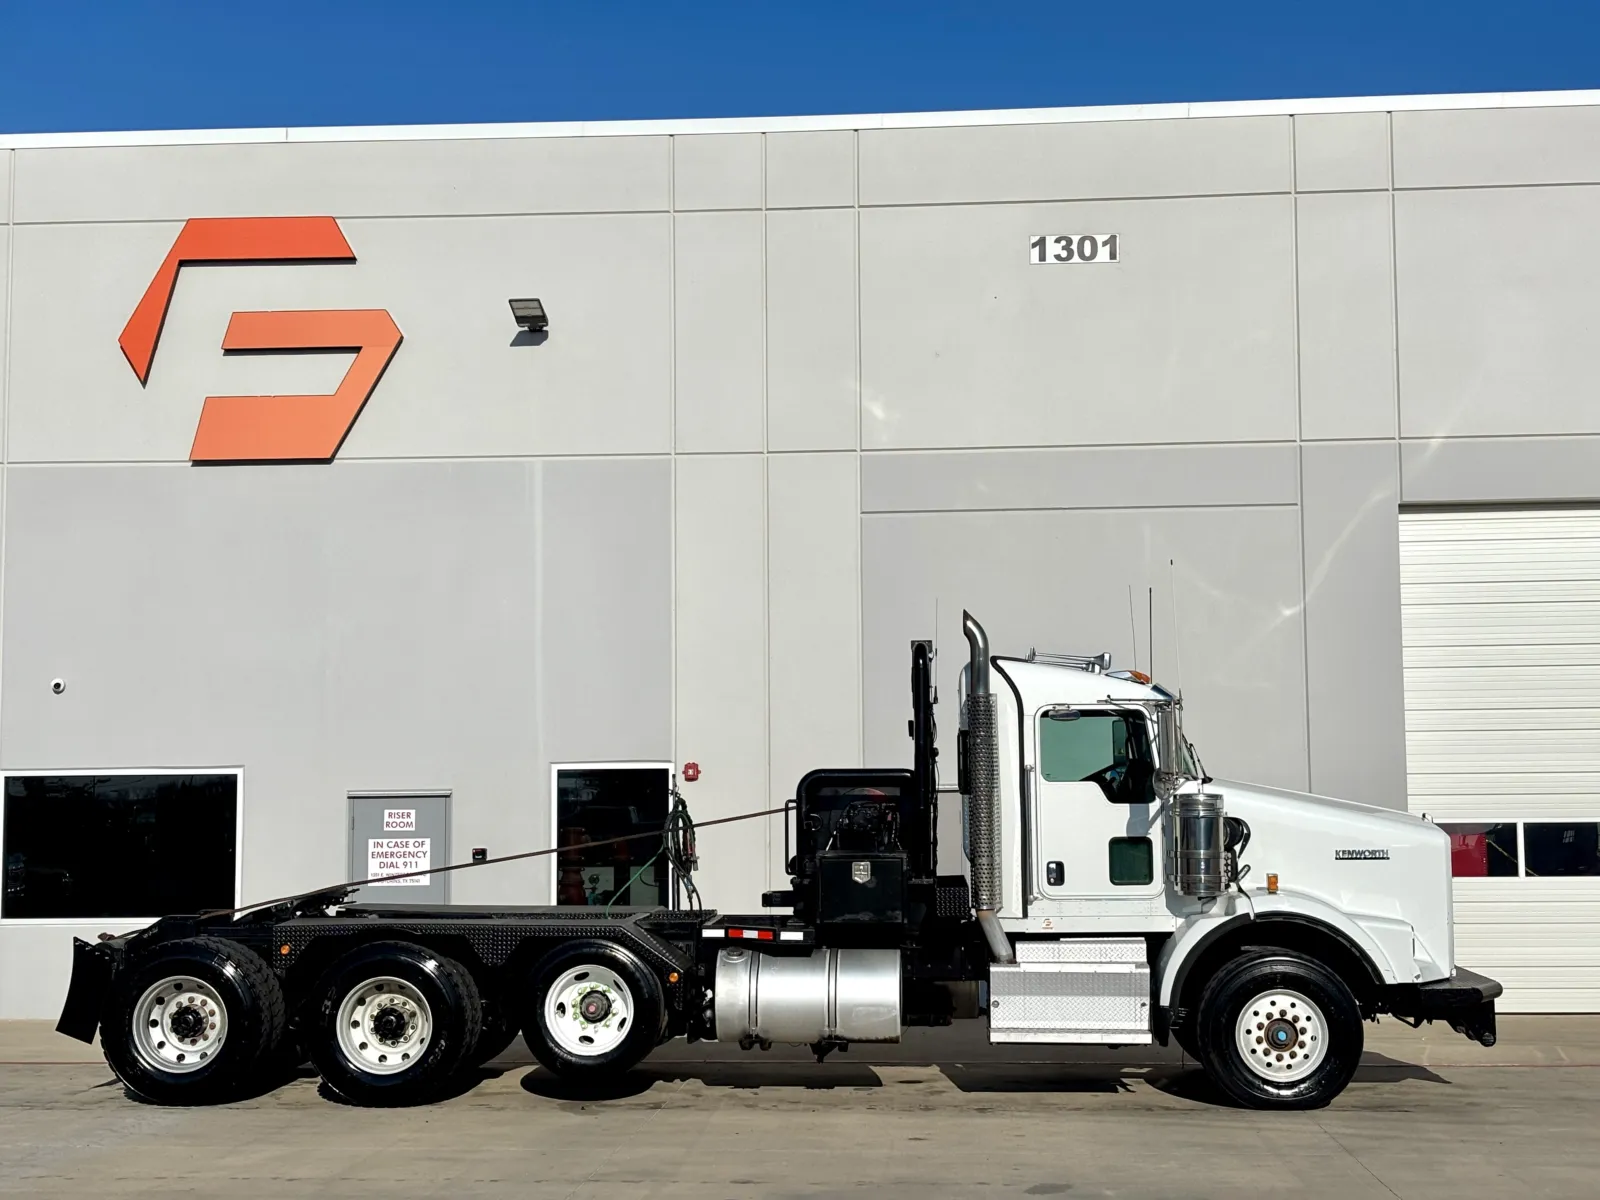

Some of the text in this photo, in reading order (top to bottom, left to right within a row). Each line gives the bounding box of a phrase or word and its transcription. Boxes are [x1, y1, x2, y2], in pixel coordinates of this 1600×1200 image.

[1031, 234, 1118, 262] 1301
[388, 811, 412, 819] RISER
[385, 821, 414, 829] ROOM
[373, 840, 426, 849] IN CASE OF
[371, 850, 428, 859] EMERGENCY
[1335, 849, 1390, 860] KENWORTH
[379, 861, 418, 869] DIAL 911
